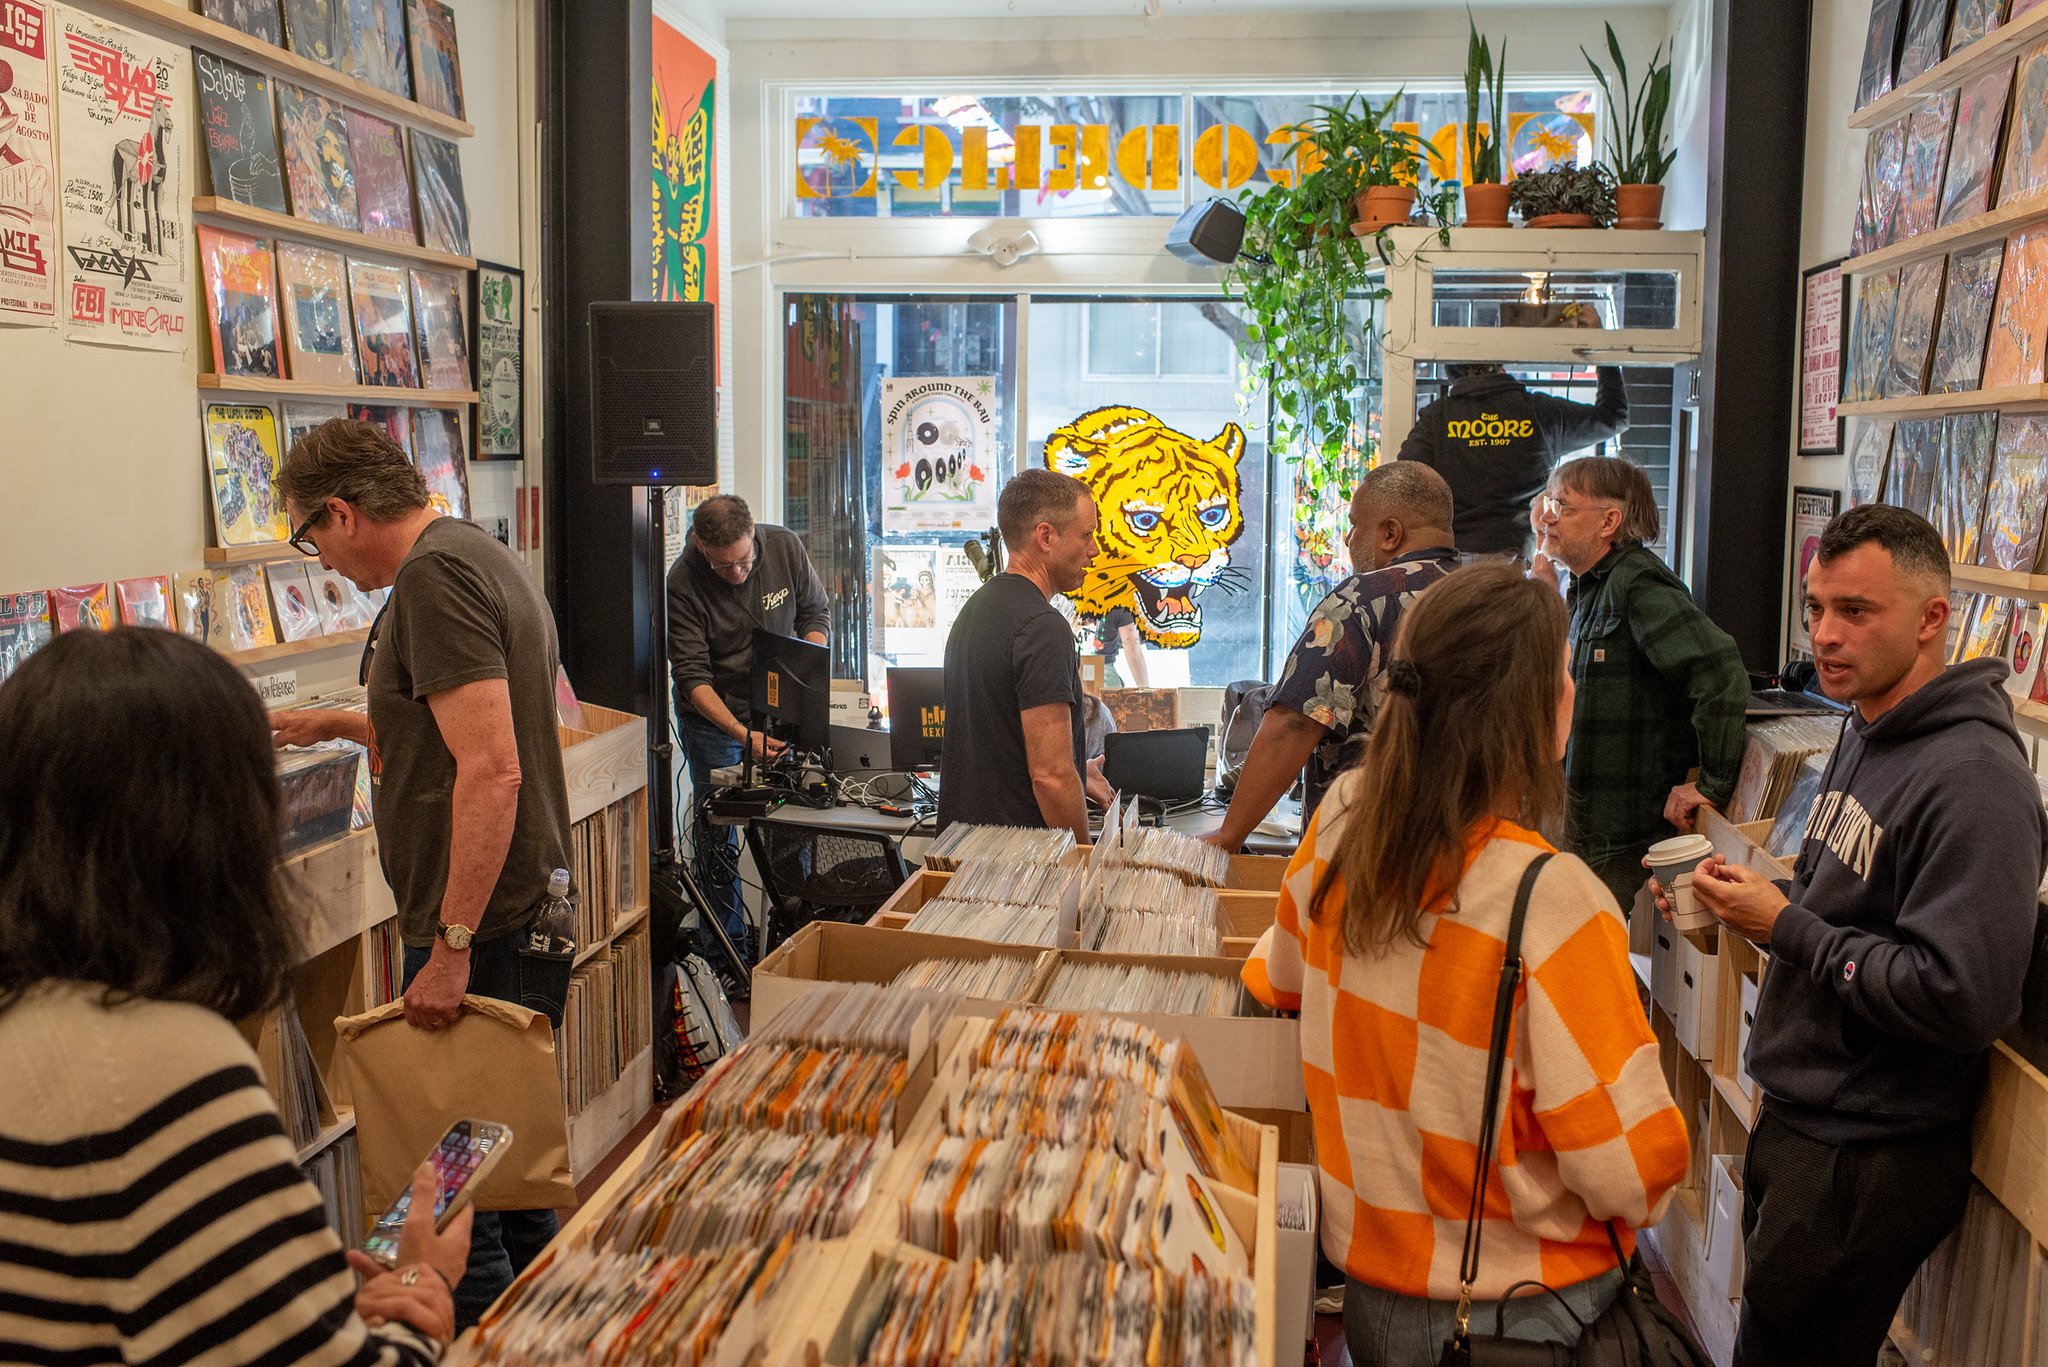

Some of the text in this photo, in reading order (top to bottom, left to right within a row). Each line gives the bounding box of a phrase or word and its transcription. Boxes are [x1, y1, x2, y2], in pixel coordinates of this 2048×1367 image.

[0, 2, 26, 47] IS
[156, 66, 169, 81] 20
[11, 86, 48, 105] SABADO
[24, 111, 37, 123] DE
[15, 125, 49, 142] AGOSTO
[886, 400, 906, 426] SPIN
[904, 382, 952, 402] AROUND
[954, 385, 975, 403] THE
[973, 400, 991, 424] BAY
[1814, 391, 1837, 405] GROUP
[1447, 419, 1534, 439] MOORE
[1469, 439, 1488, 447] EST.
[1796, 496, 1832, 518] FESTIVAL
[269, 676, 296, 698] Releases
